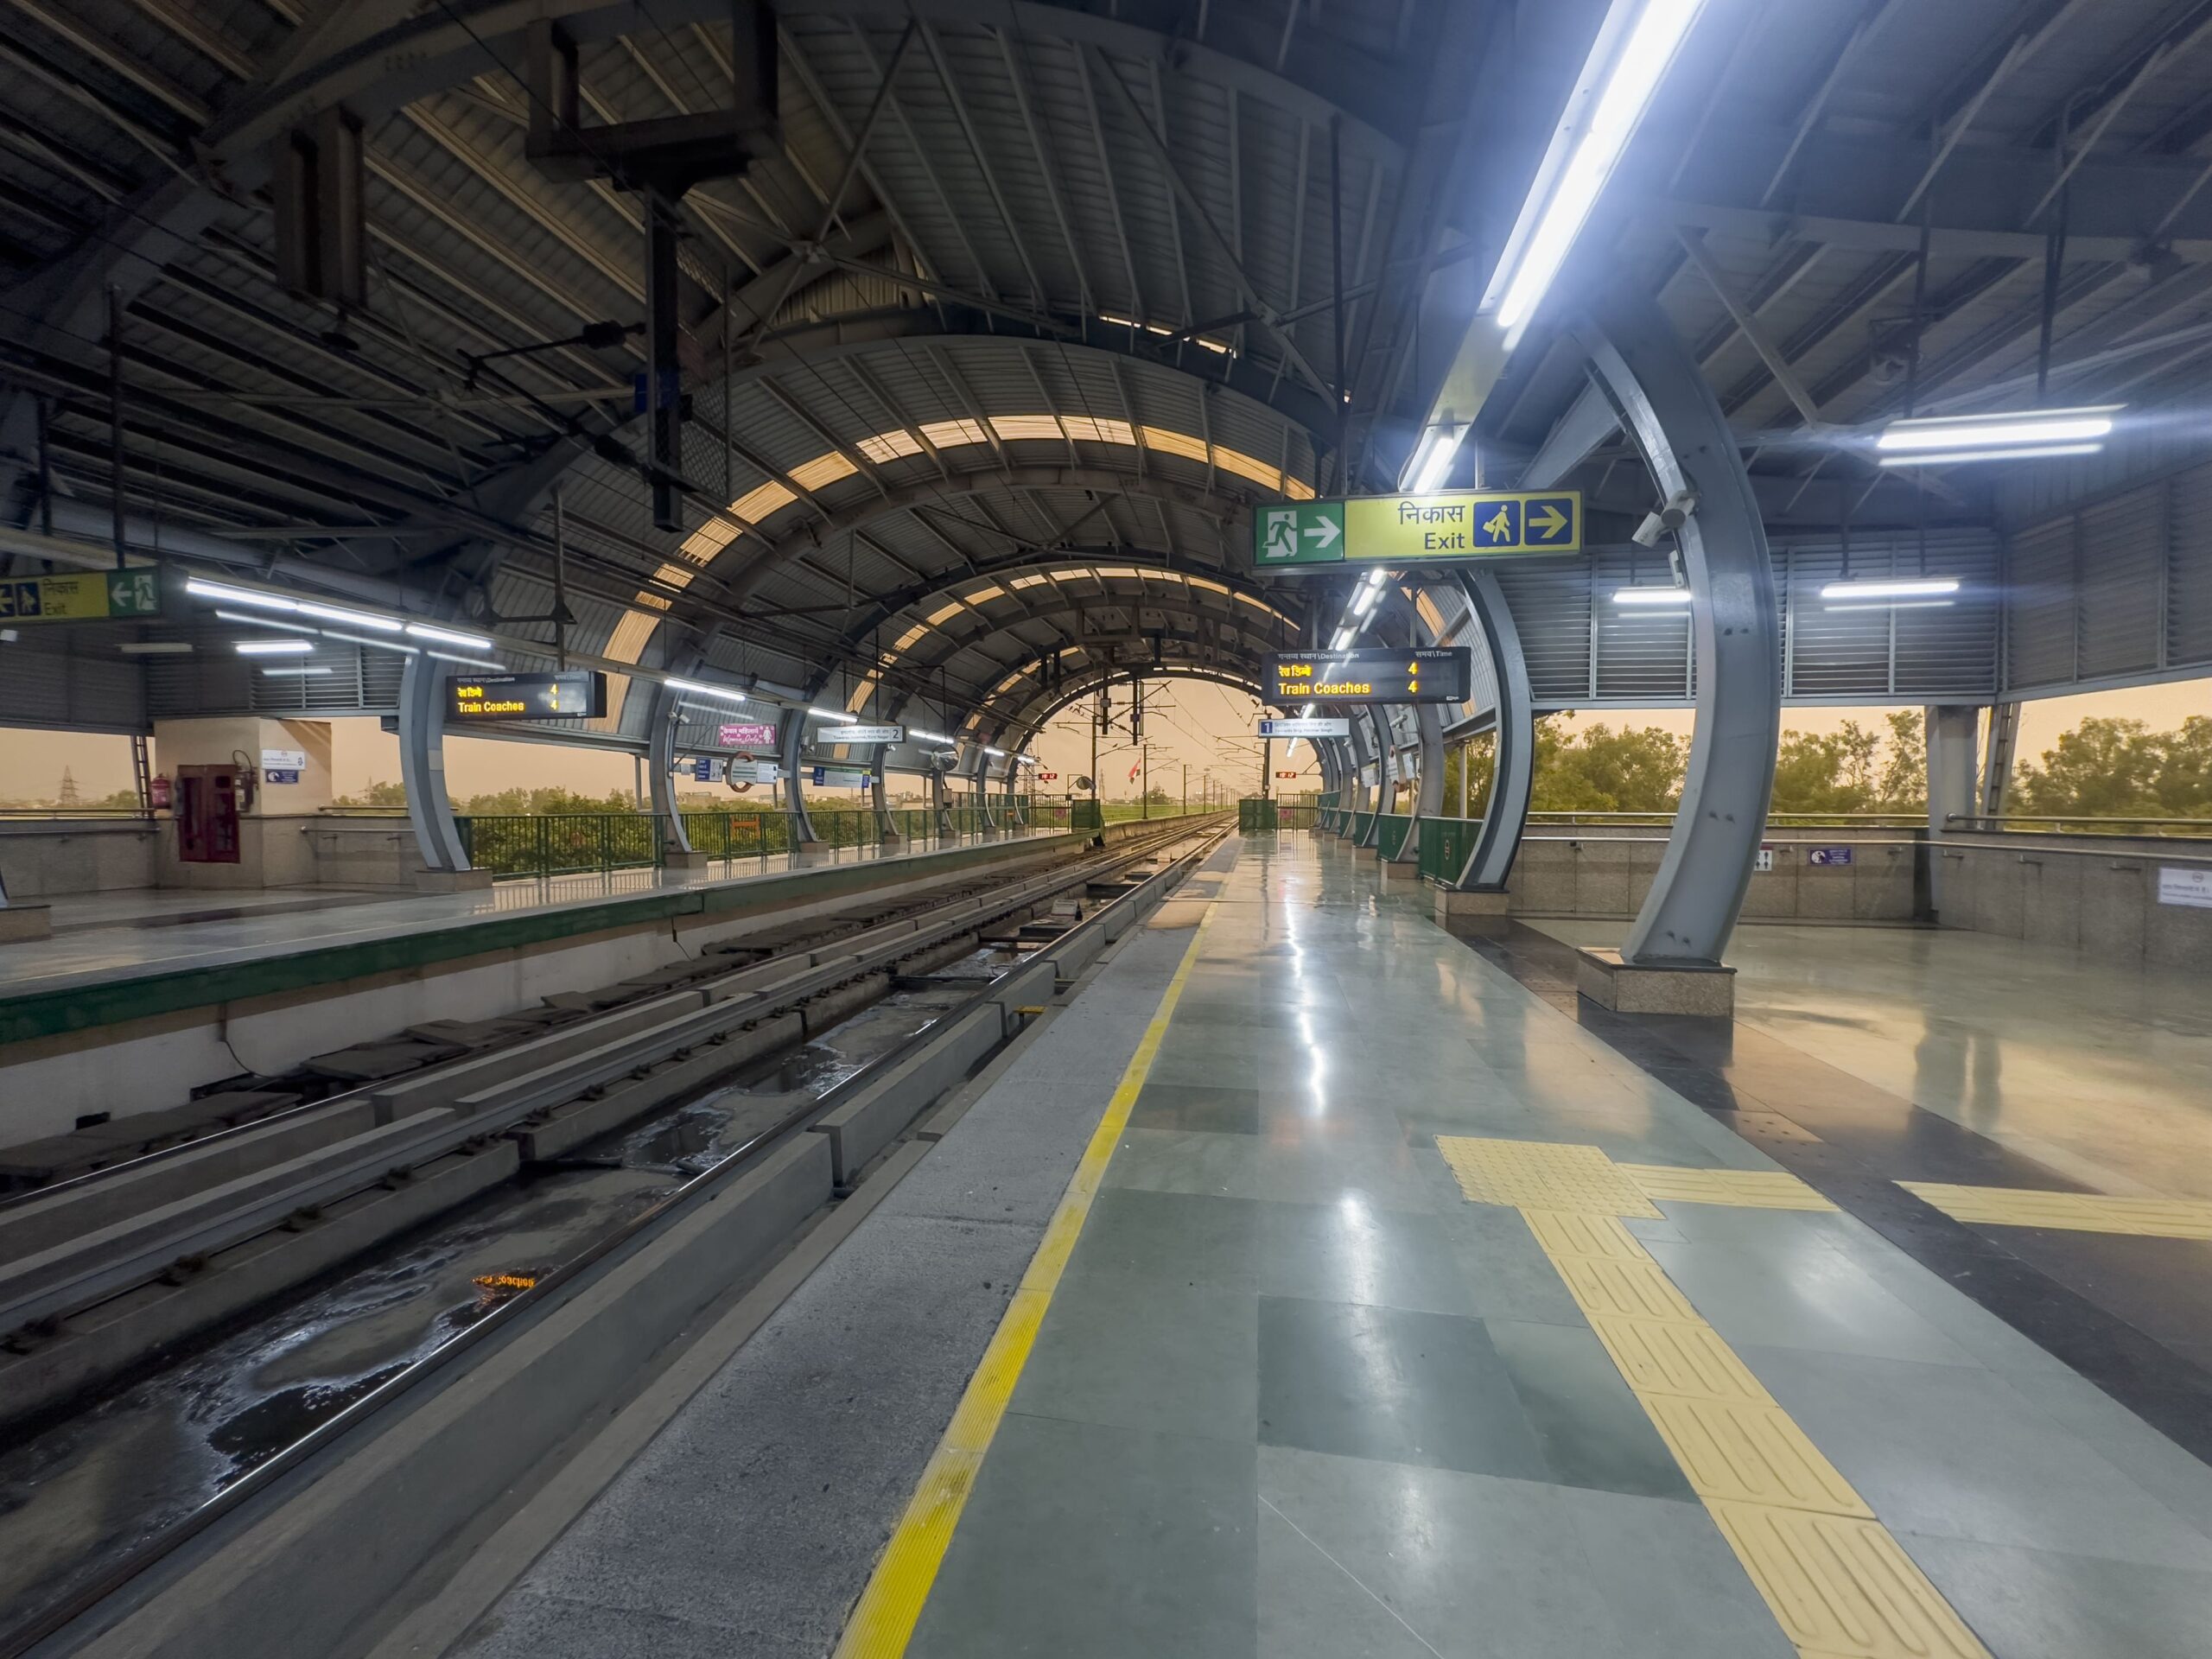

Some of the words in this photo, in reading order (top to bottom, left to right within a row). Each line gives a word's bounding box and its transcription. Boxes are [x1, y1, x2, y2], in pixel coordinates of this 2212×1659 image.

[1397, 501, 1465, 524] निकास
[1424, 532, 1465, 550] Exit
[45, 602, 68, 615] Exit
[1408, 662, 1418, 675] 4
[550, 683, 558, 695] 4
[1279, 683, 1310, 695] Train
[1313, 682, 1370, 695] Coaches
[1408, 680, 1418, 693] 4
[458, 702, 481, 713] Train
[484, 702, 524, 712] Coaches
[550, 699, 558, 710] 4
[893, 729, 899, 739] 2
